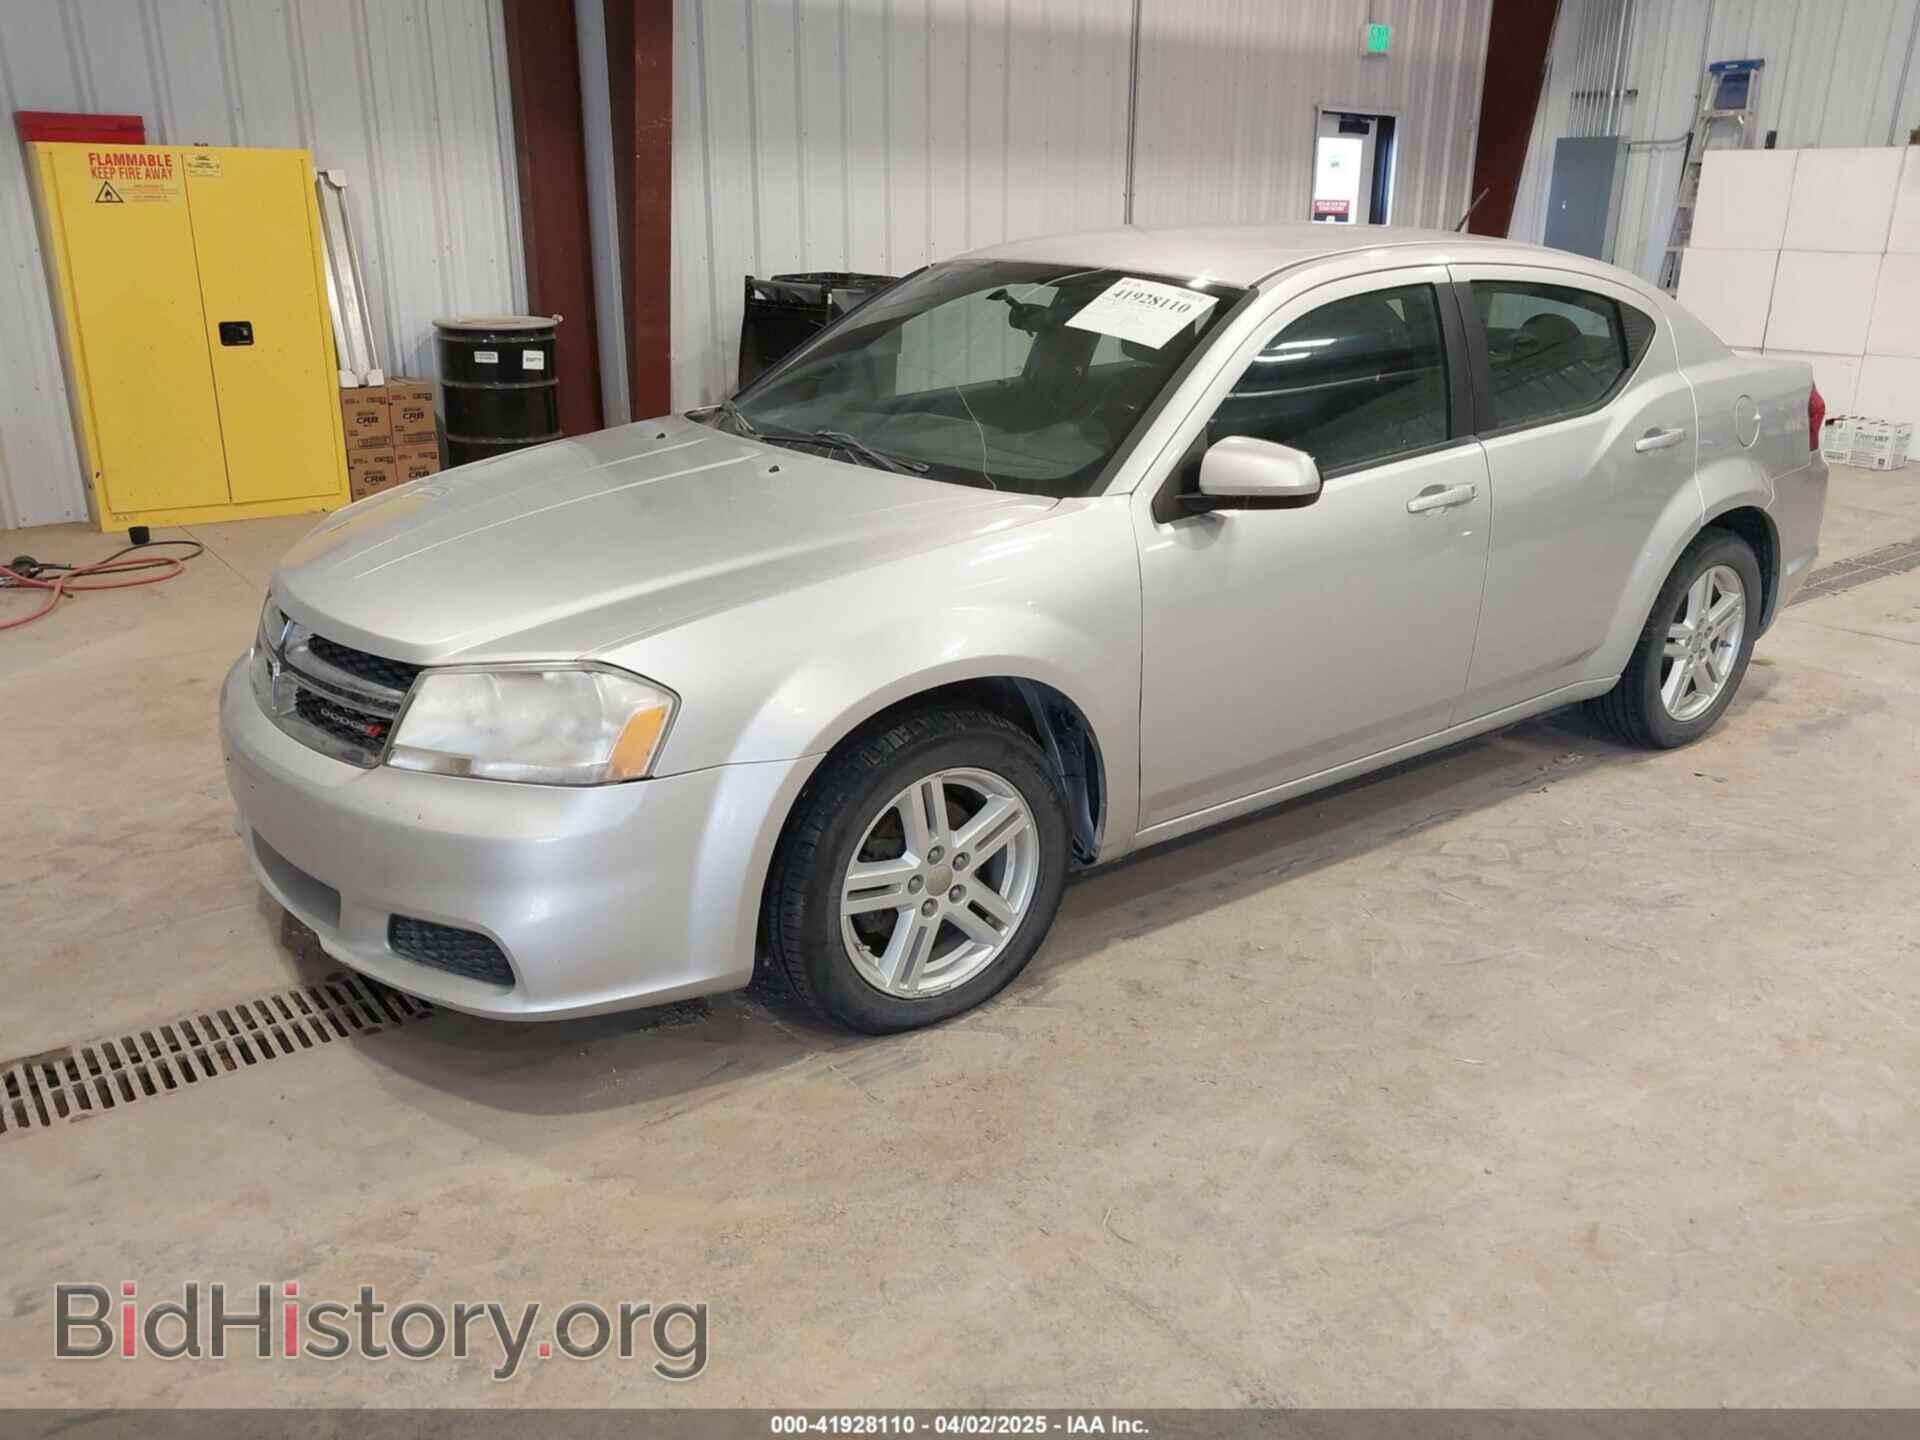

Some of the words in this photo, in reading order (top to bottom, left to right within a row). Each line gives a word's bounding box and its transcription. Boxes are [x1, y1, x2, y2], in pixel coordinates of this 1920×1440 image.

[88, 152, 172, 167] FLAMMABLE
[91, 165, 116, 180] KEEP
[119, 166, 142, 180] FIRE
[144, 167, 173, 181] AWAY
[1113, 289, 1192, 313] 41928110
